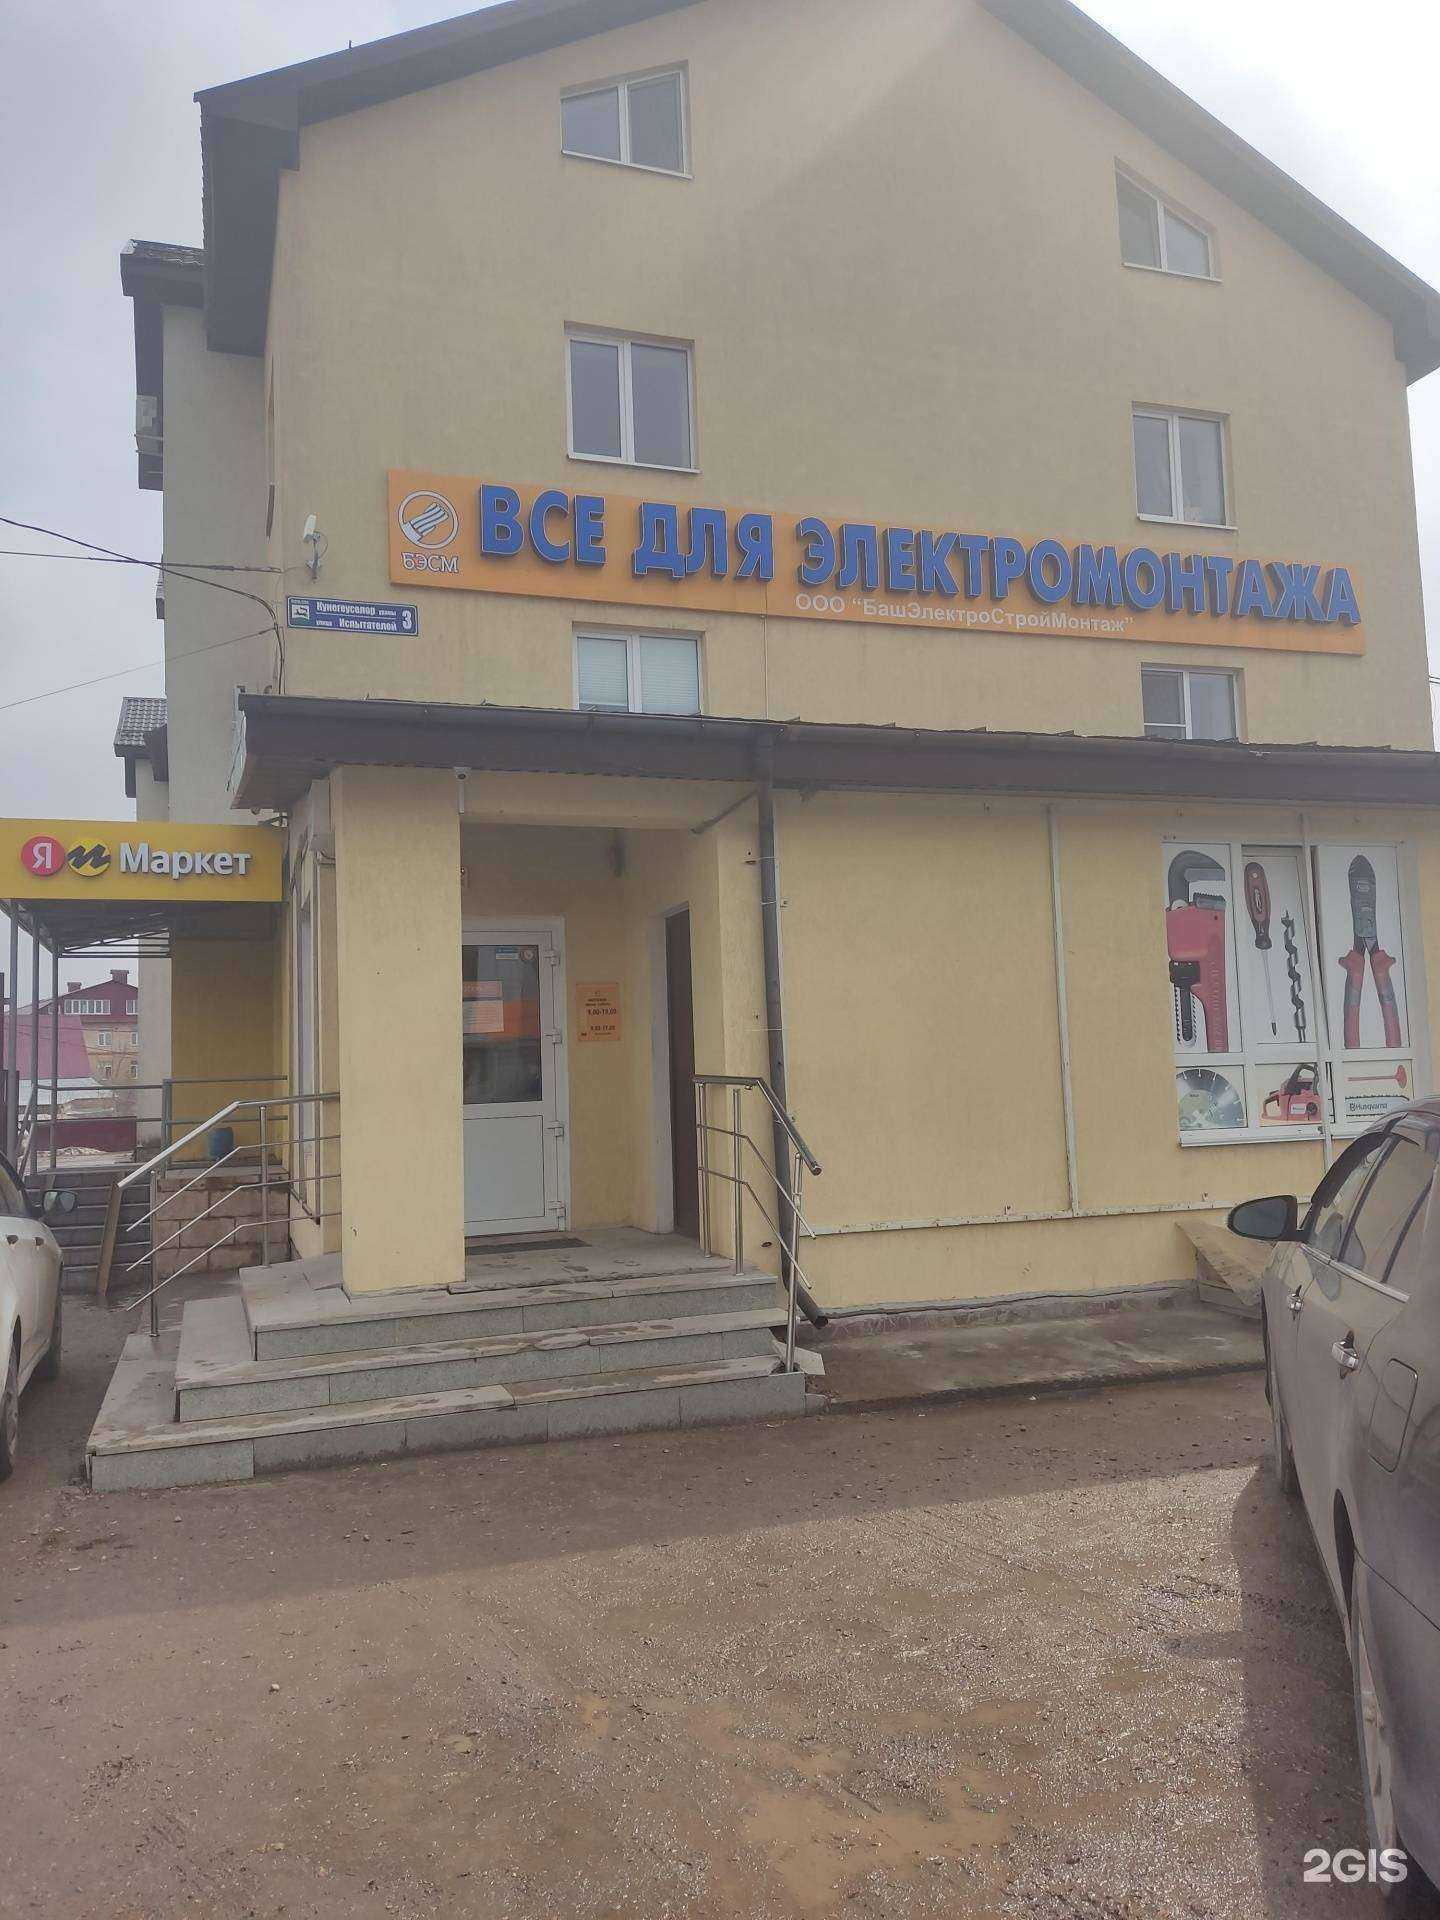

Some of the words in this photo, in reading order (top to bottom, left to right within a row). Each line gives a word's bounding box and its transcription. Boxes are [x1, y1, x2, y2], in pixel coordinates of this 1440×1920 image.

[401, 551, 460, 575] БЭСМ
[480, 483, 607, 566] ВСЕ
[633, 502, 774, 580] ДЛЯ
[796, 516, 1362, 625] ЭЛЕКТРОМОНТАЖА
[795, 592, 845, 613] ООО
[401, 610, 412, 629] 3
[120, 842, 252, 880] Маркет
